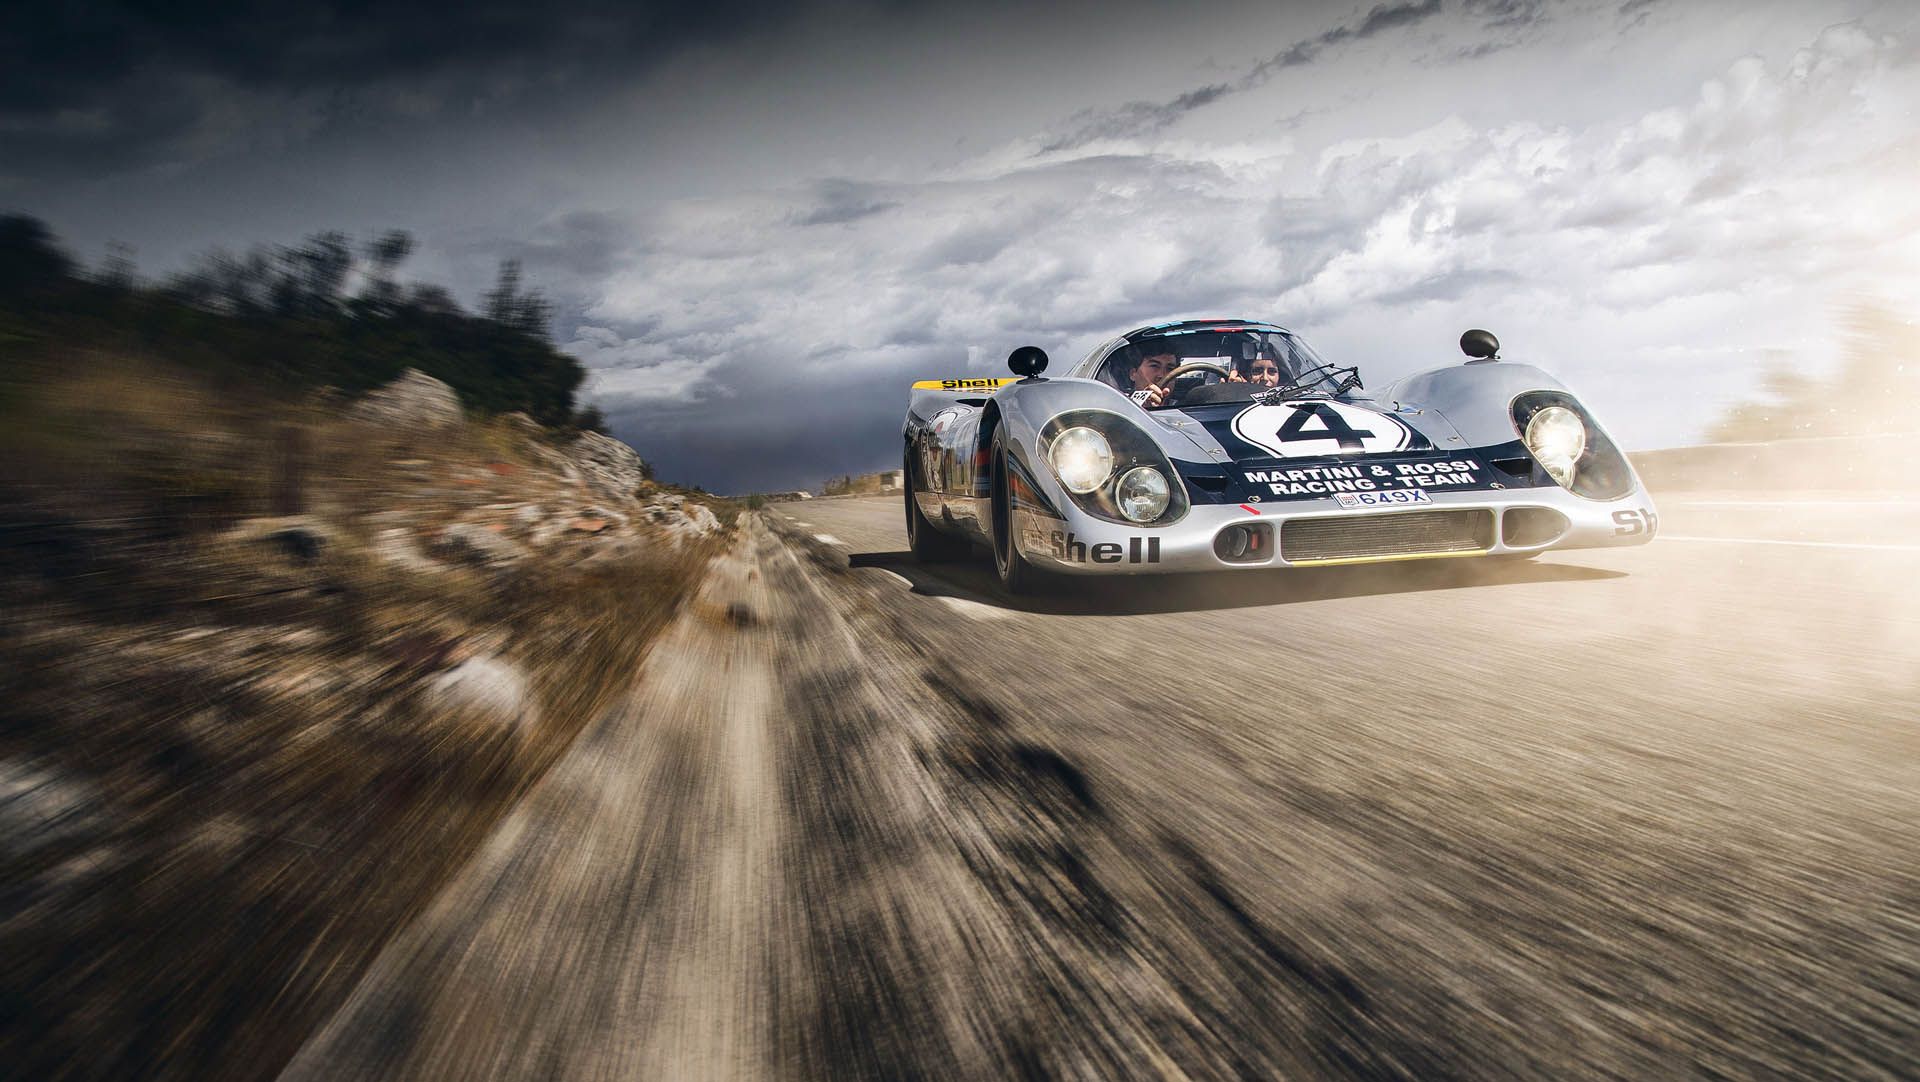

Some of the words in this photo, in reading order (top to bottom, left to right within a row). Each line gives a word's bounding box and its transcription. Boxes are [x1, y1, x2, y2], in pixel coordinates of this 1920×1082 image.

[942, 379, 998, 388] Shell
[1276, 403, 1376, 449] 4
[1244, 466, 1362, 483] MARTINI
[1371, 465, 1391, 477] &
[1396, 460, 1480, 475] ROSSI
[1269, 478, 1376, 495] RACING
[1399, 473, 1476, 488] TEAM
[1359, 490, 1426, 504] 649X
[1051, 530, 1160, 563] Shell
